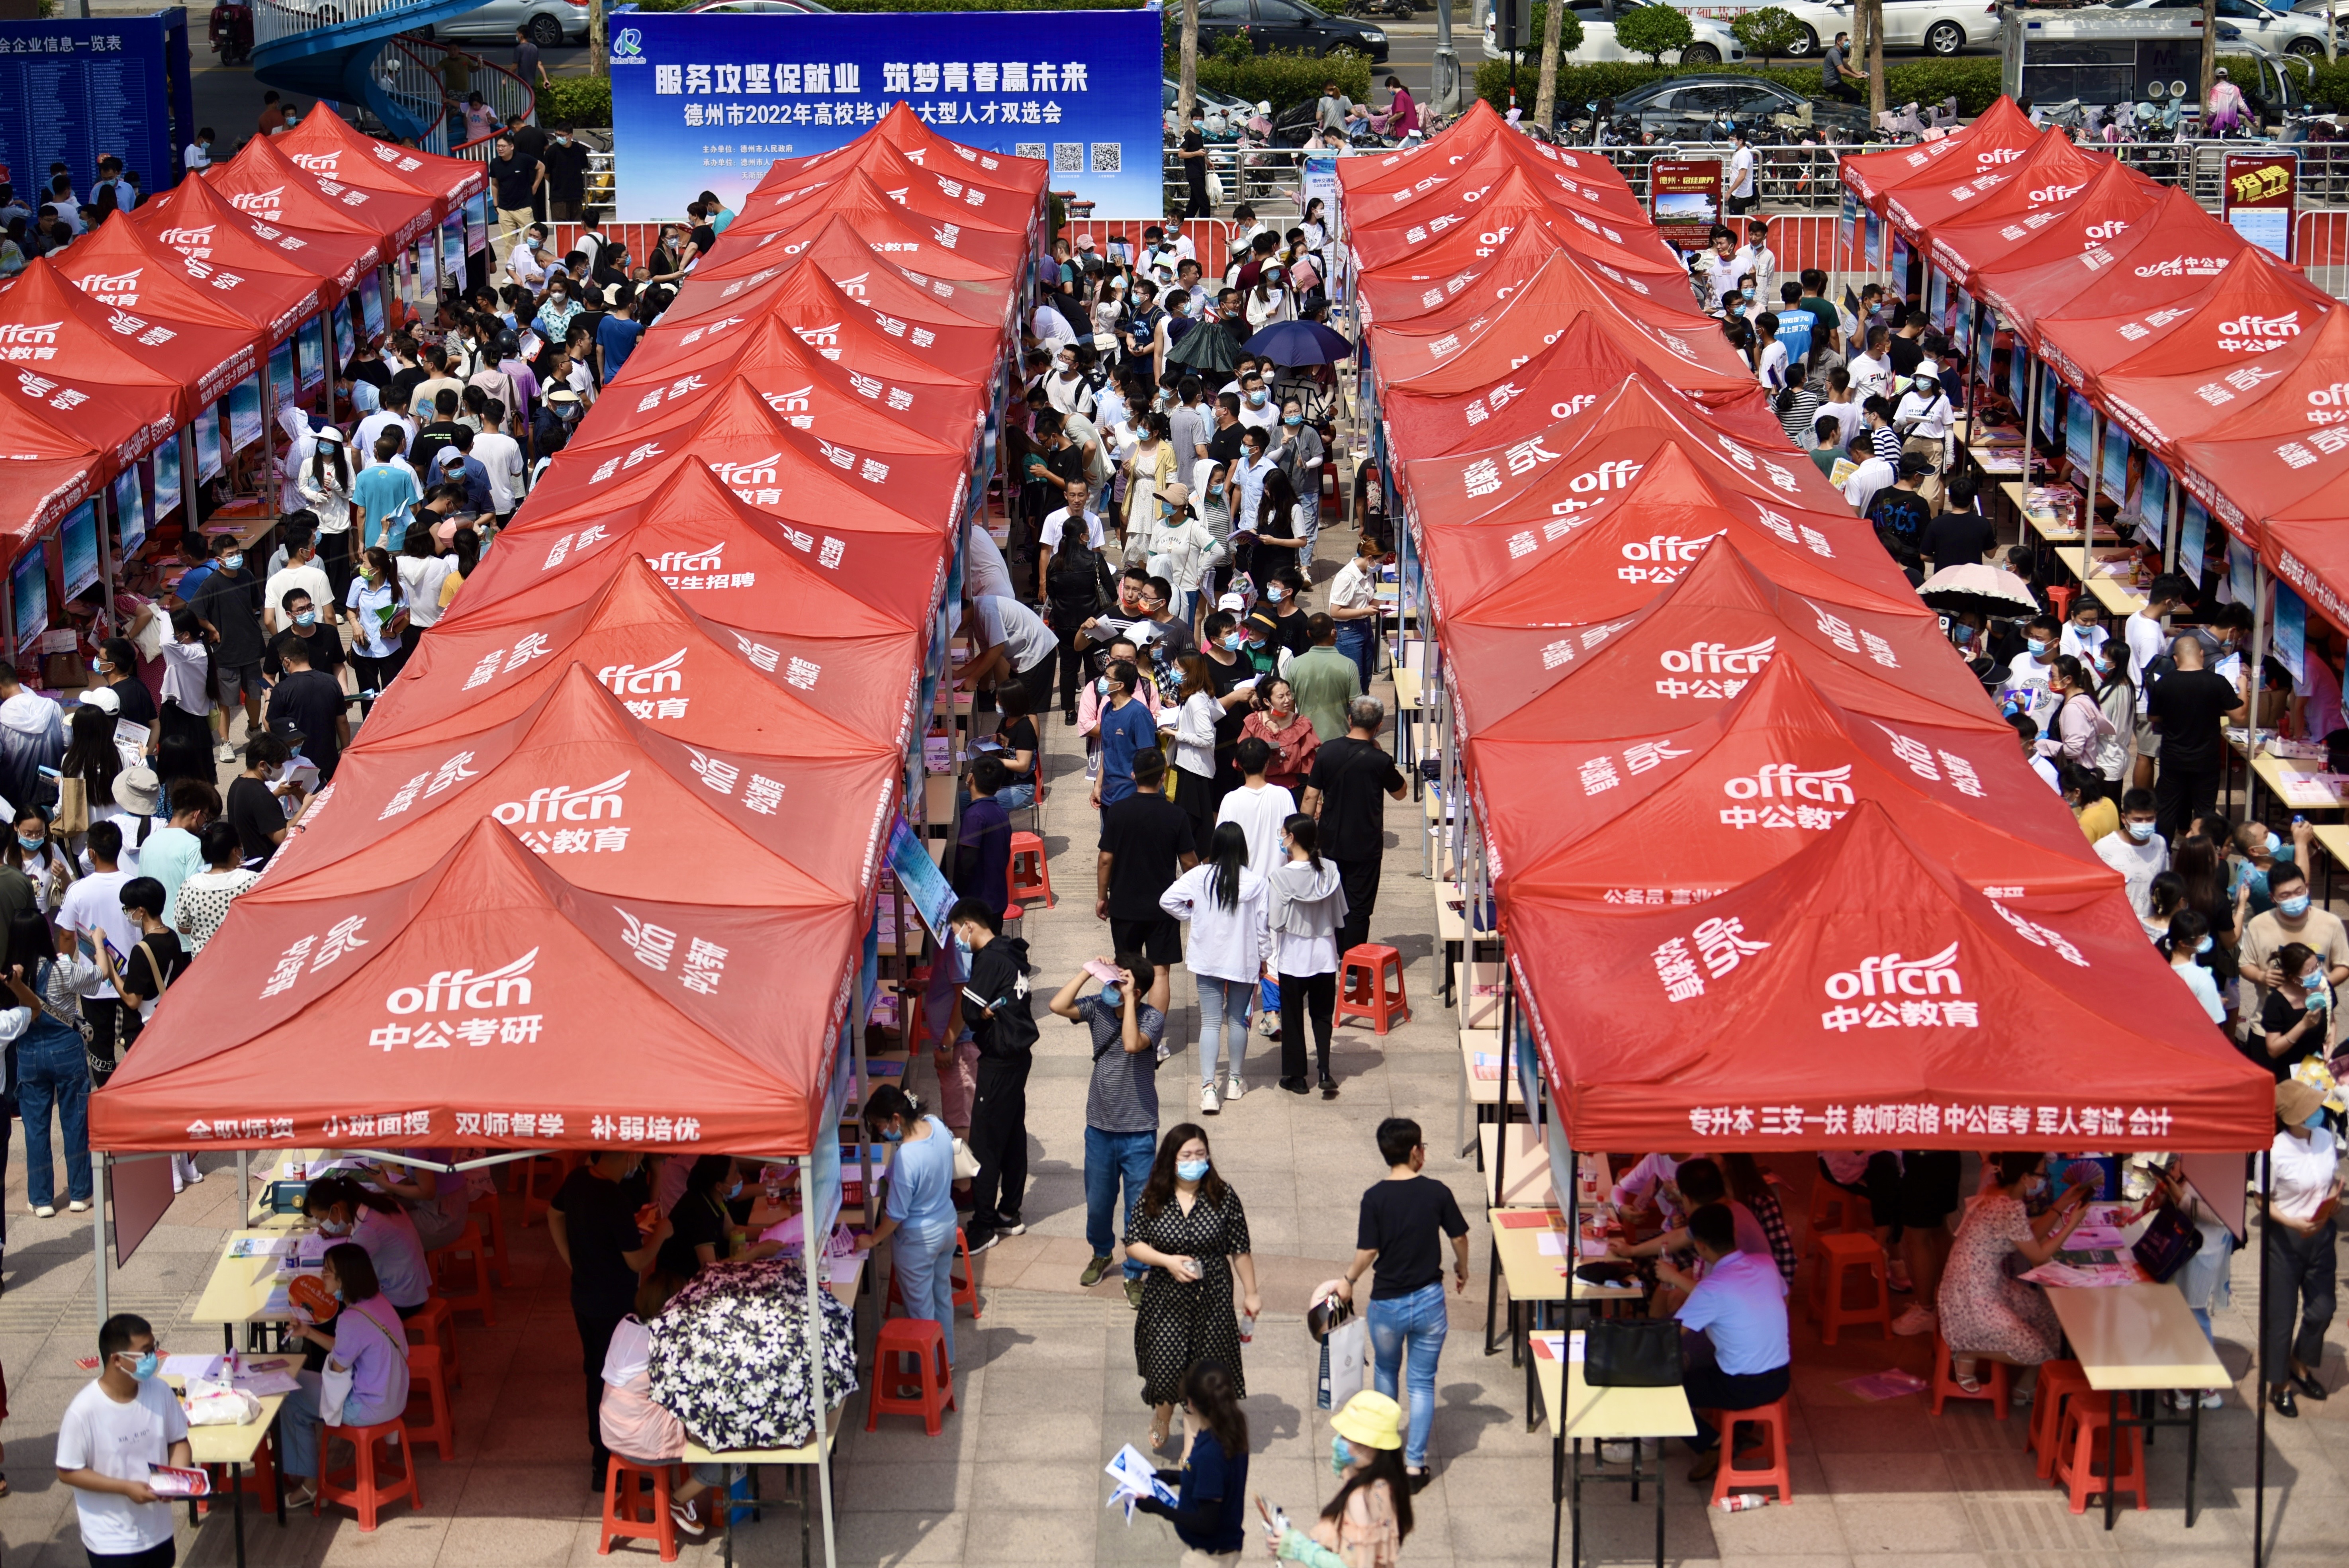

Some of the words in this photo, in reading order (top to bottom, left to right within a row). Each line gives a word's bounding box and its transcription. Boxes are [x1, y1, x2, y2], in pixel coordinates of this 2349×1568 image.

[0, 35, 121, 53] 会企业信息一览表
[655, 63, 861, 95] 服务攻坚促就业
[883, 62, 1088, 93] 筑梦青春赢未来
[684, 101, 1063, 127] 德州市2022年高校毕业大型人才双选会
[291, 150, 342, 169] ffcn
[740, 144, 793, 153] 德州市人民政府
[2231, 165, 2289, 202] 招聘
[227, 186, 285, 209] ffcn
[159, 225, 216, 244] ffcn
[2086, 221, 2129, 238] off
[870, 243, 919, 251] 公教育
[2185, 256, 2230, 268] 中公教
[74, 268, 143, 291] ffcn
[95, 294, 139, 306] 教育
[0, 322, 63, 343] ffcn
[2218, 311, 2300, 336] offcn
[0, 346, 58, 360] 教育
[2218, 338, 2287, 352] 中公教
[2308, 383, 2349, 405] off
[1551, 395, 1595, 418] off
[709, 453, 781, 484] ffcn
[1570, 460, 1643, 492] off
[732, 488, 783, 505] 教育
[646, 542, 725, 571] offcn
[1622, 529, 1727, 561] offc
[661, 572, 755, 589] 卫生招聘
[1618, 565, 1687, 583] 中公
[1661, 636, 1776, 673] offcn
[596, 647, 687, 695] ffcn
[1656, 678, 1748, 699] 中公教
[623, 698, 689, 719] 教育
[1724, 763, 1854, 804] offcn
[492, 770, 630, 824] offcn
[1720, 804, 1846, 830] 中公教
[519, 826, 630, 854] 公教育
[1603, 889, 1664, 904] 公务员
[386, 947, 539, 1014] offcn
[1825, 941, 1961, 999] offcn
[1822, 1000, 1978, 1032] 中公教育
[369, 1015, 543, 1051] 中公考研
[186, 1117, 295, 1139] 全职师资
[323, 1110, 430, 1137] 小班面授
[456, 1112, 564, 1137] 双师督学
[591, 1115, 700, 1141] 补弱培优
[1689, 1106, 1754, 1135] 专升本
[1760, 1105, 1847, 1134] 三支一扶
[1853, 1103, 1940, 1134] 教师资格
[1944, 1103, 2031, 1134] 中公医考
[2036, 1106, 2124, 1135] 军人考试
[2129, 1107, 2173, 1136] 会计
